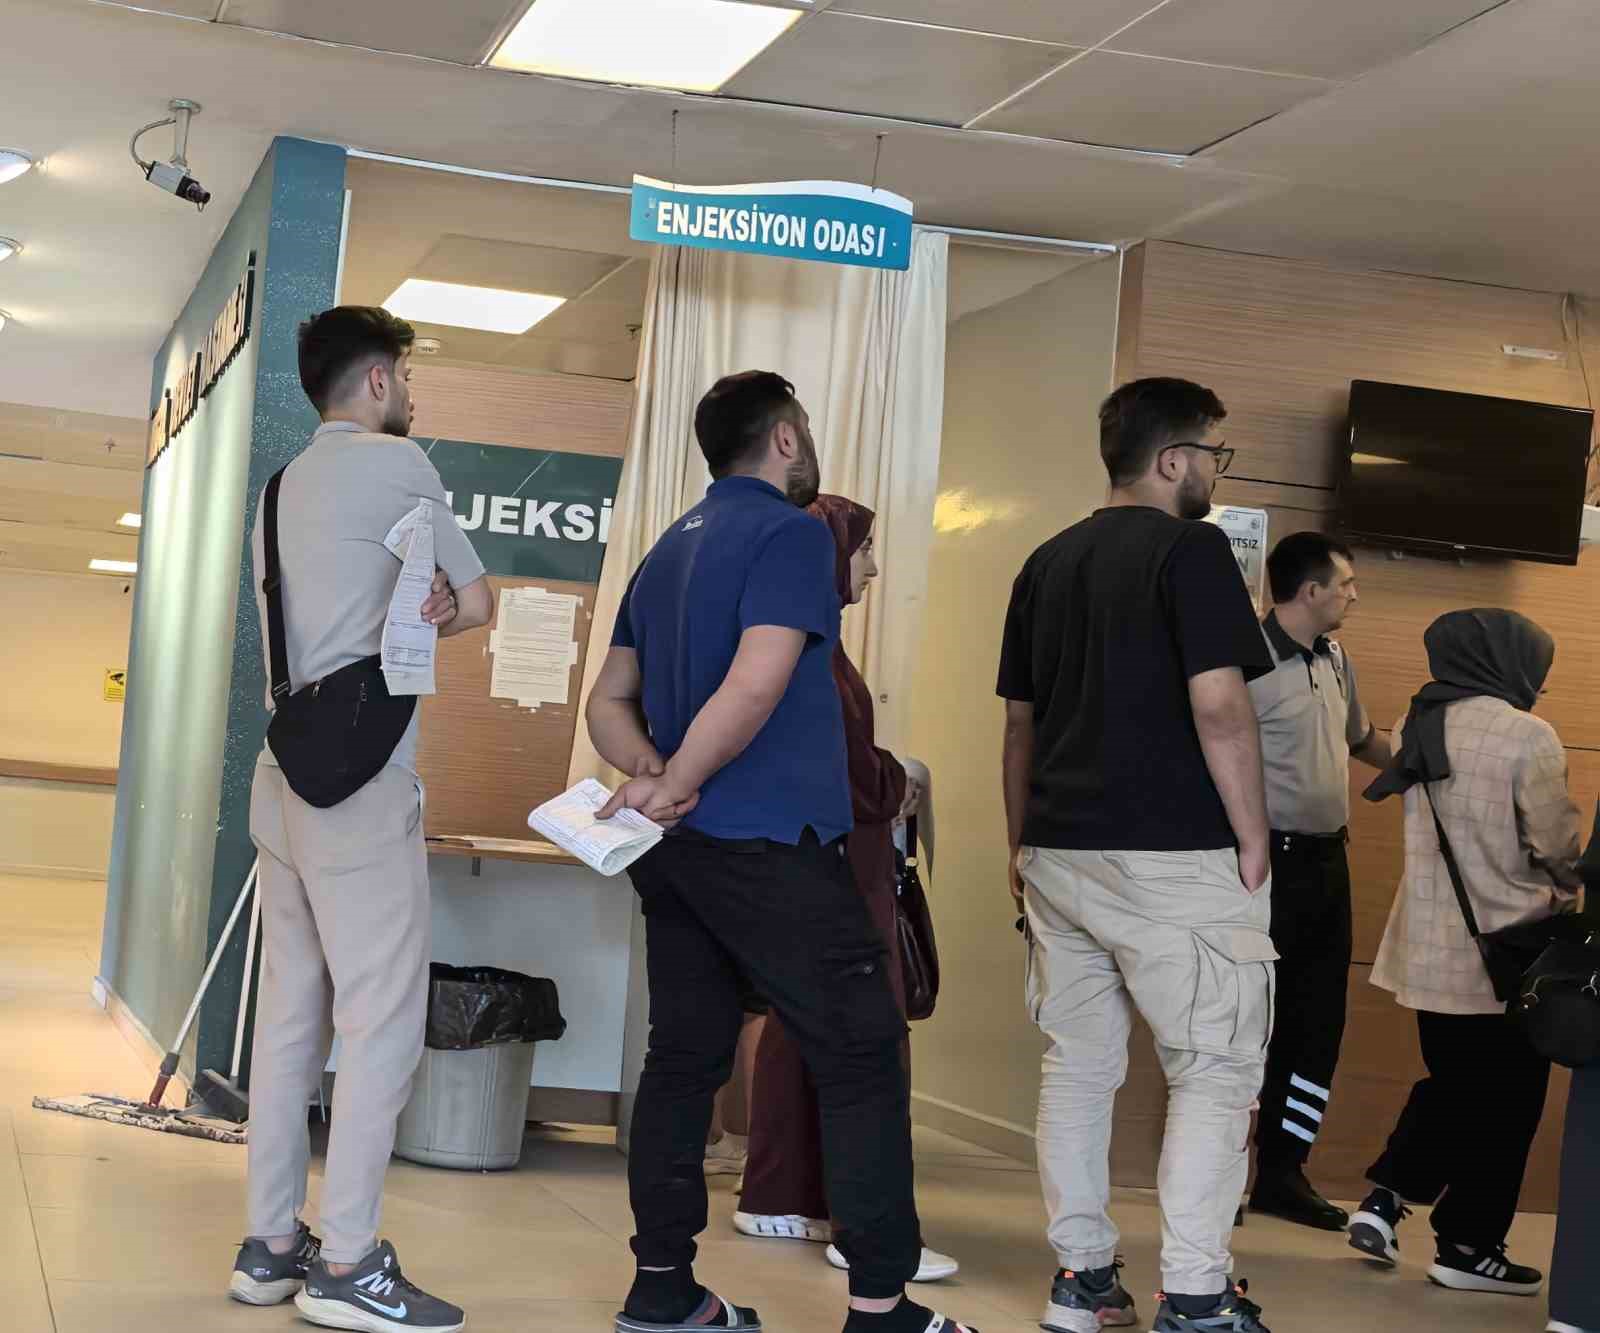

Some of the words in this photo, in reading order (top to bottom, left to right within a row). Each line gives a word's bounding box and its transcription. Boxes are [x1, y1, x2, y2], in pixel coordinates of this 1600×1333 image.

[656, 200, 807, 249] ENJEKSİYON
[813, 218, 887, 259] ODASI
[446, 491, 613, 544] JEKSİ
